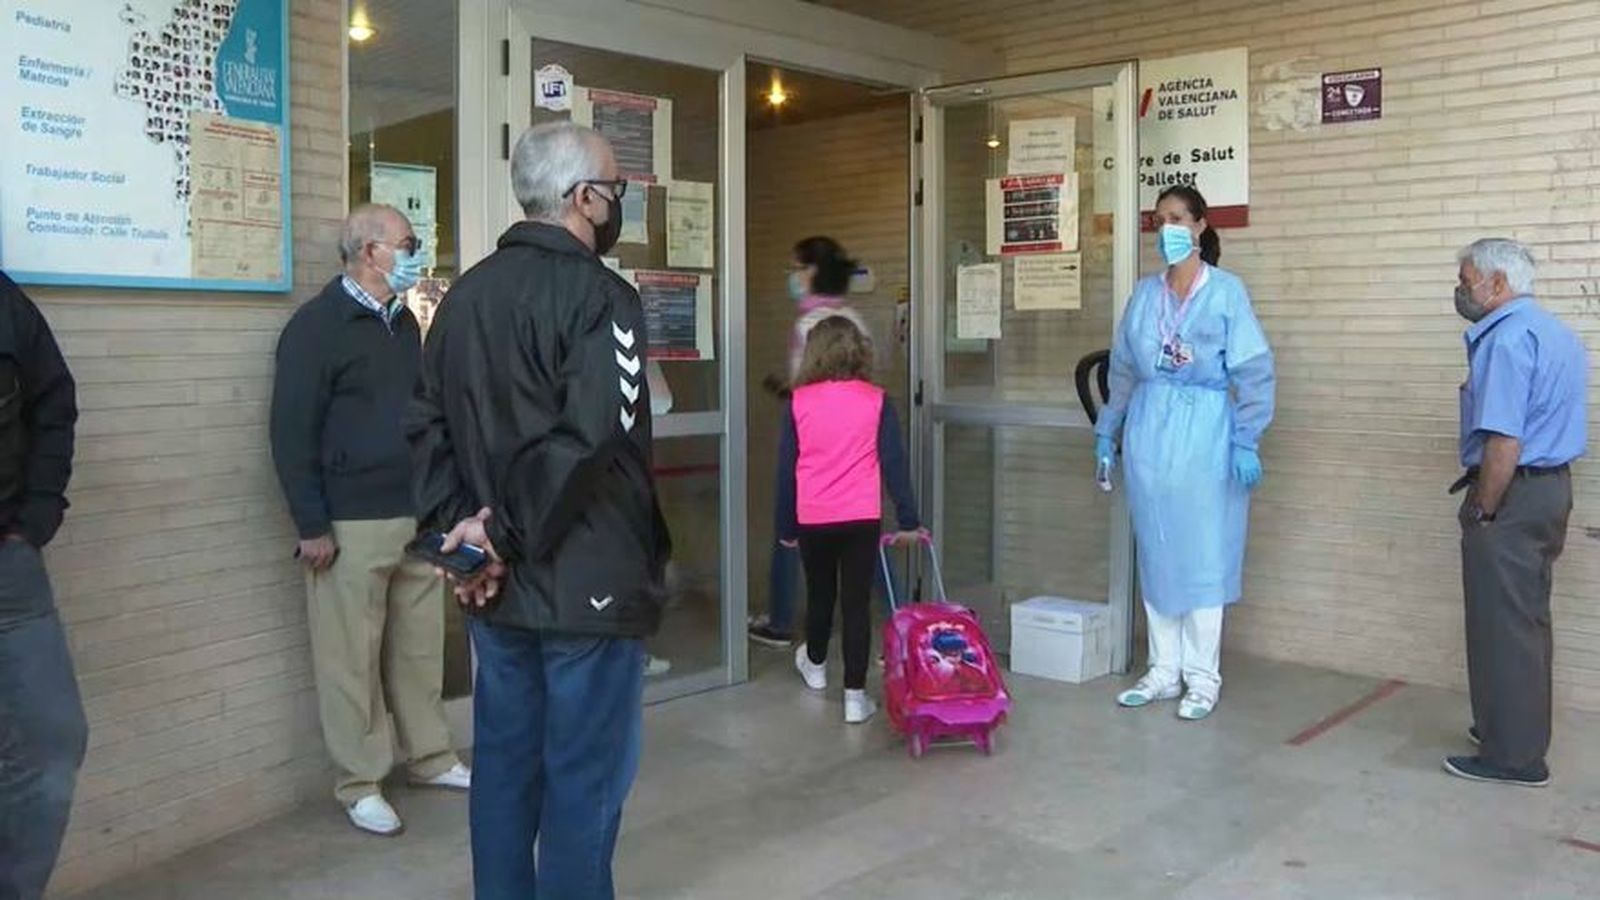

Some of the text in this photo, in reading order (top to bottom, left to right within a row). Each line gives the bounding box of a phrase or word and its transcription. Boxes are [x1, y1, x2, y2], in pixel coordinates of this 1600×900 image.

[20, 69, 69, 88] Matrona
[1158, 89, 1237, 107] VALENCIANA
[1158, 105, 1216, 120] DE SALUT
[21, 120, 82, 140] de Sangre
[1163, 152, 1181, 165] de
[1191, 146, 1235, 163] Salut
[26, 163, 126, 184] Trabajador Social
[27, 206, 62, 221] Punto
